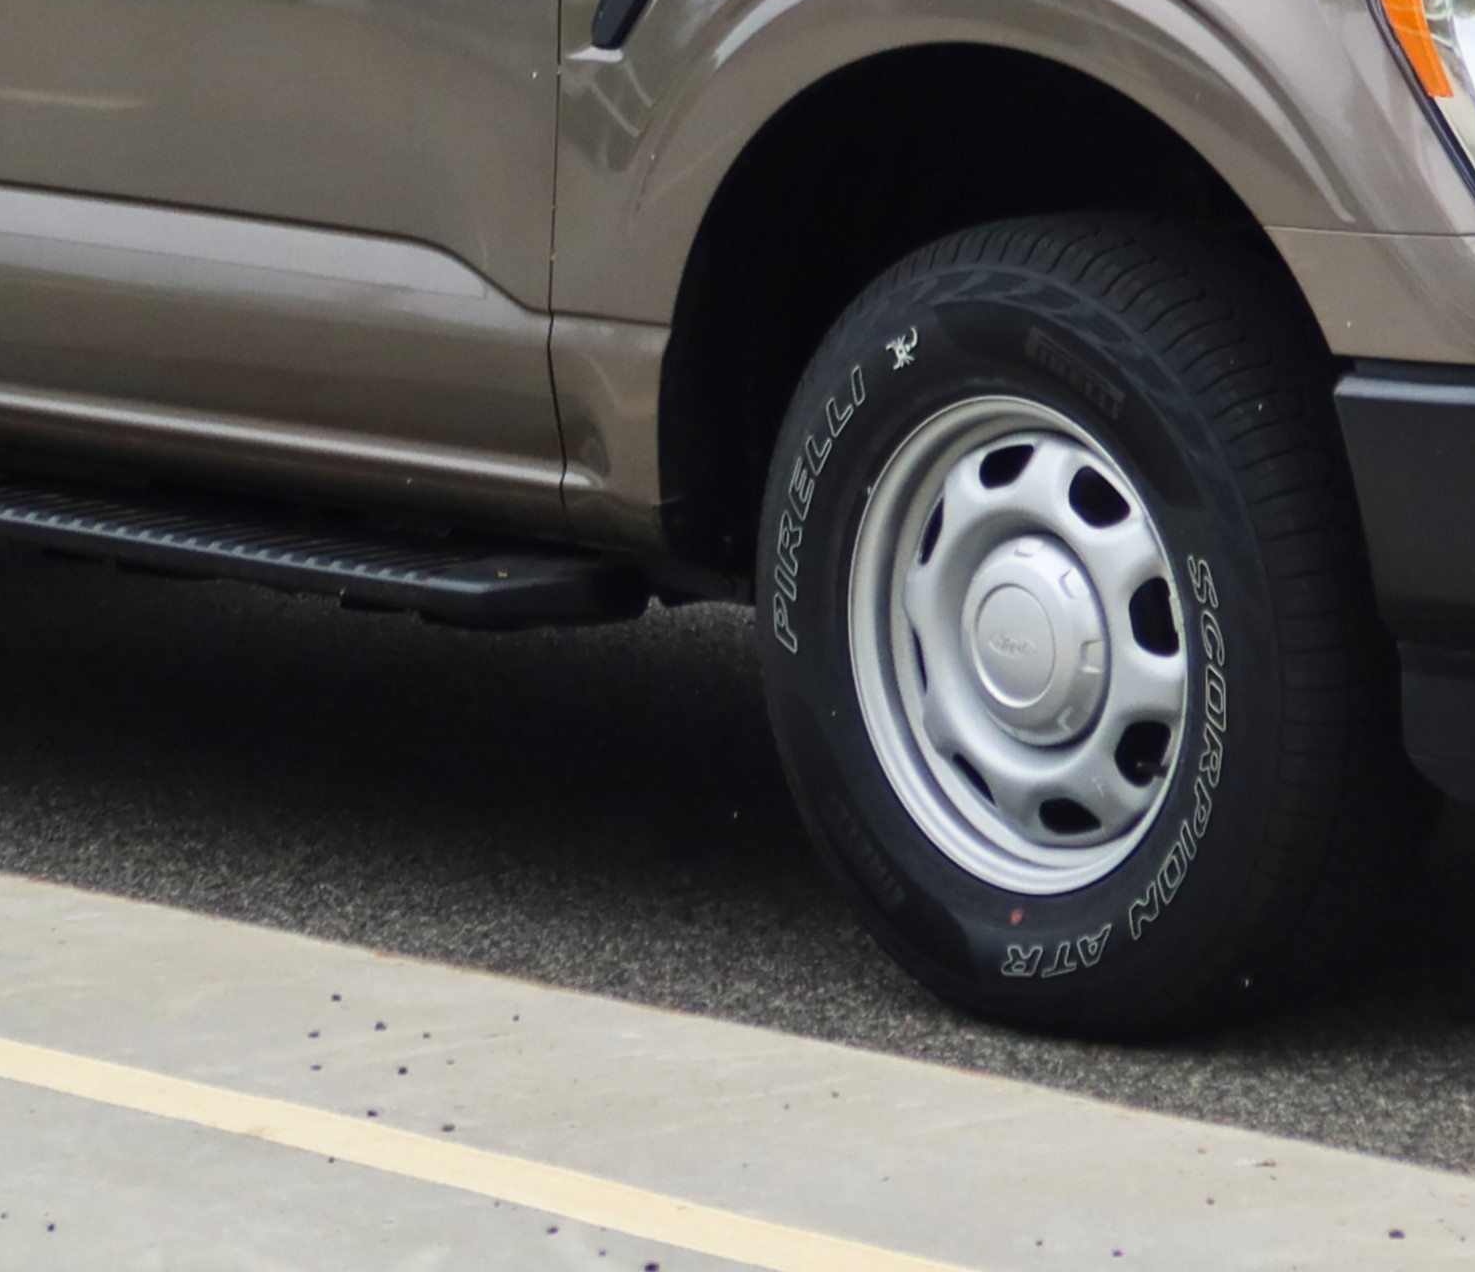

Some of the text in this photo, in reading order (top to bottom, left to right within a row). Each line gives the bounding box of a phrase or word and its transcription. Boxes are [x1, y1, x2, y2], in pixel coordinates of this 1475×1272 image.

[773, 364, 867, 655] PIRELLI
[1000, 553, 1228, 979] SCORPION ATR
